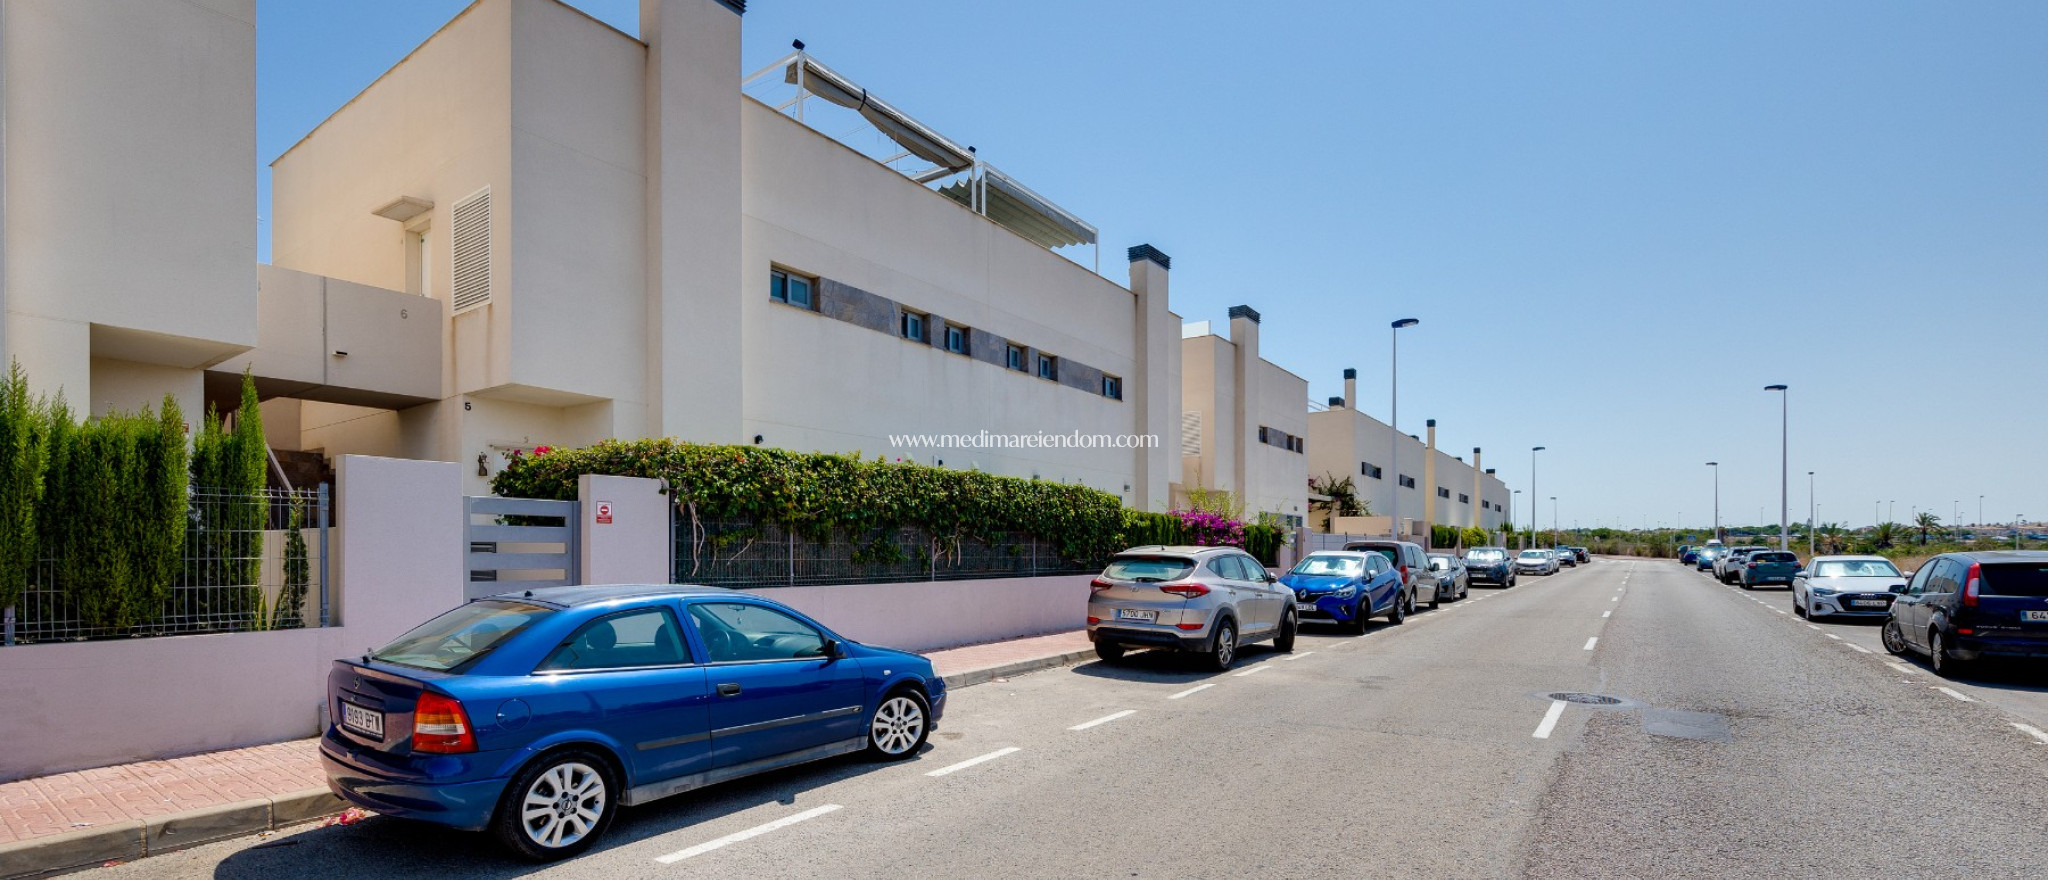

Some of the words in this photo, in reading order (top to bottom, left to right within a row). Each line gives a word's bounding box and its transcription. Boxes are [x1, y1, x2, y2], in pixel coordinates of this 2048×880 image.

[400, 309, 408, 320] 6
[464, 402, 472, 411] 5
[2031, 611, 2048, 620] 64
[346, 706, 364, 726] 9193
